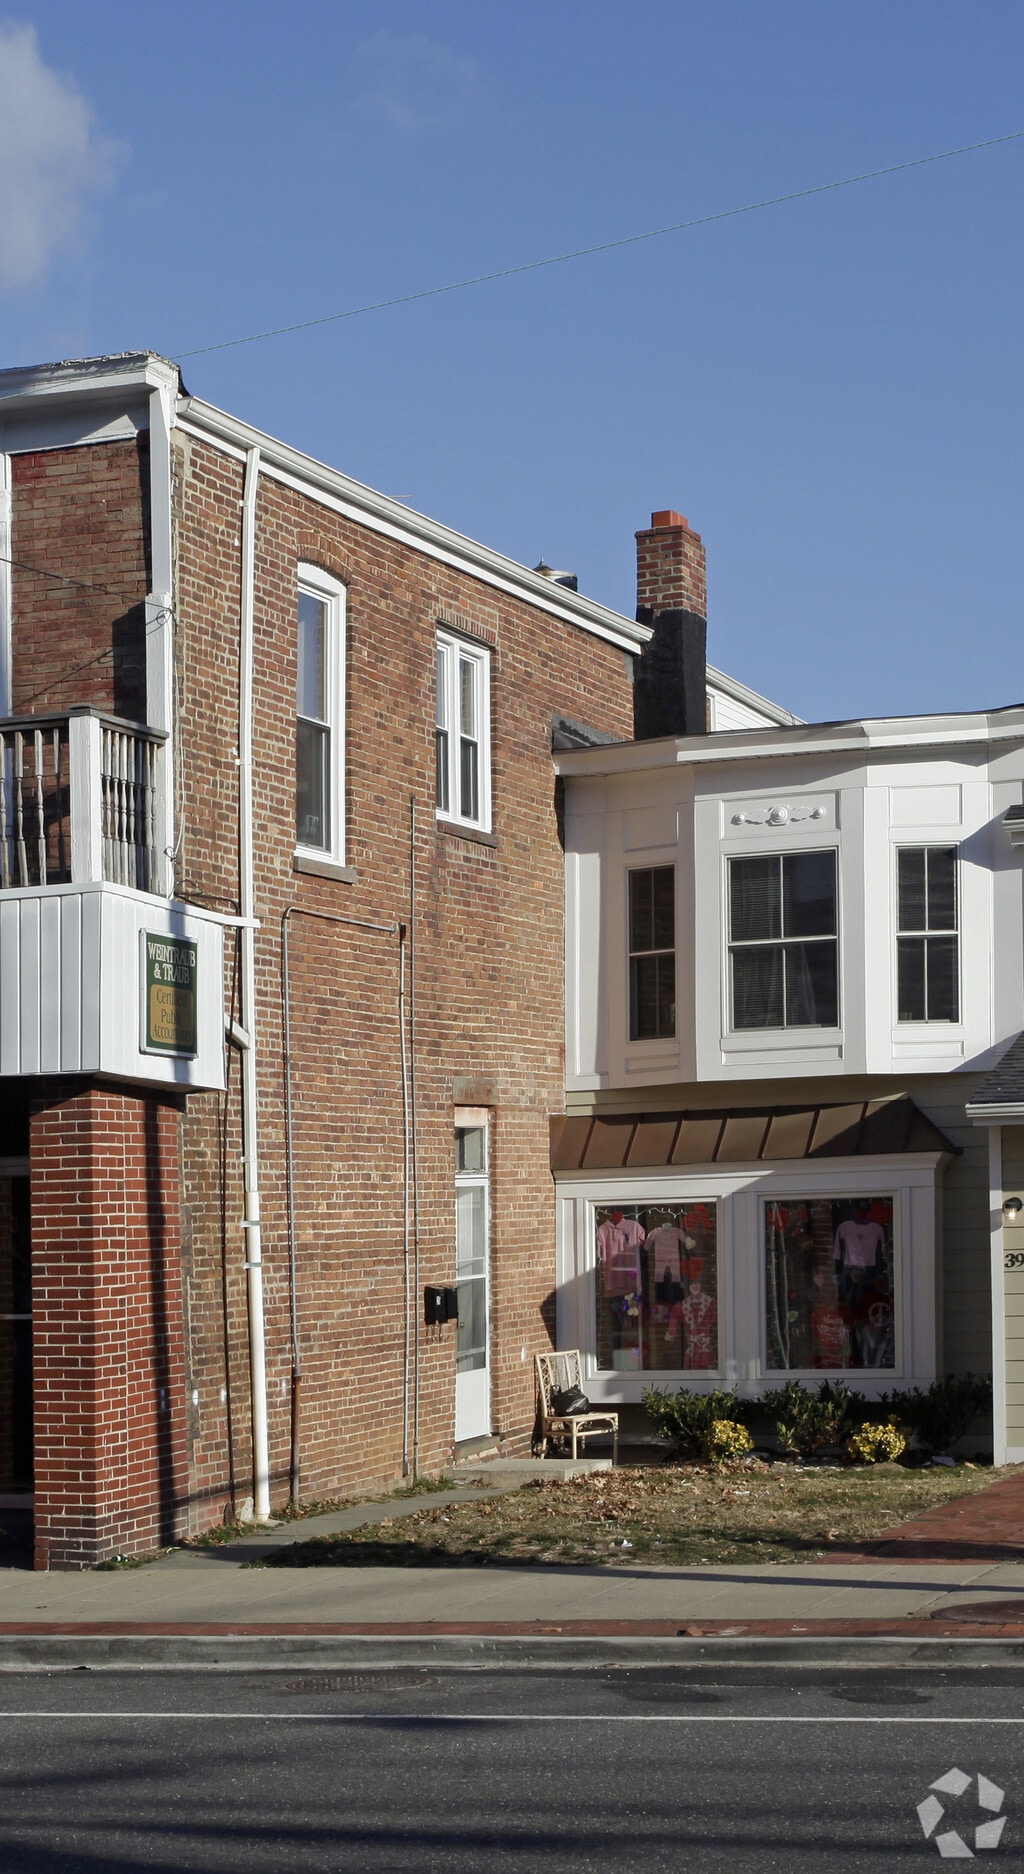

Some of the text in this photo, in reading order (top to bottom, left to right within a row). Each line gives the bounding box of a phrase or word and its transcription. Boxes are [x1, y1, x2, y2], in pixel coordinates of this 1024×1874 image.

[148, 942, 196, 967] WEINTRAUB
[153, 963, 190, 984] & TRAUB
